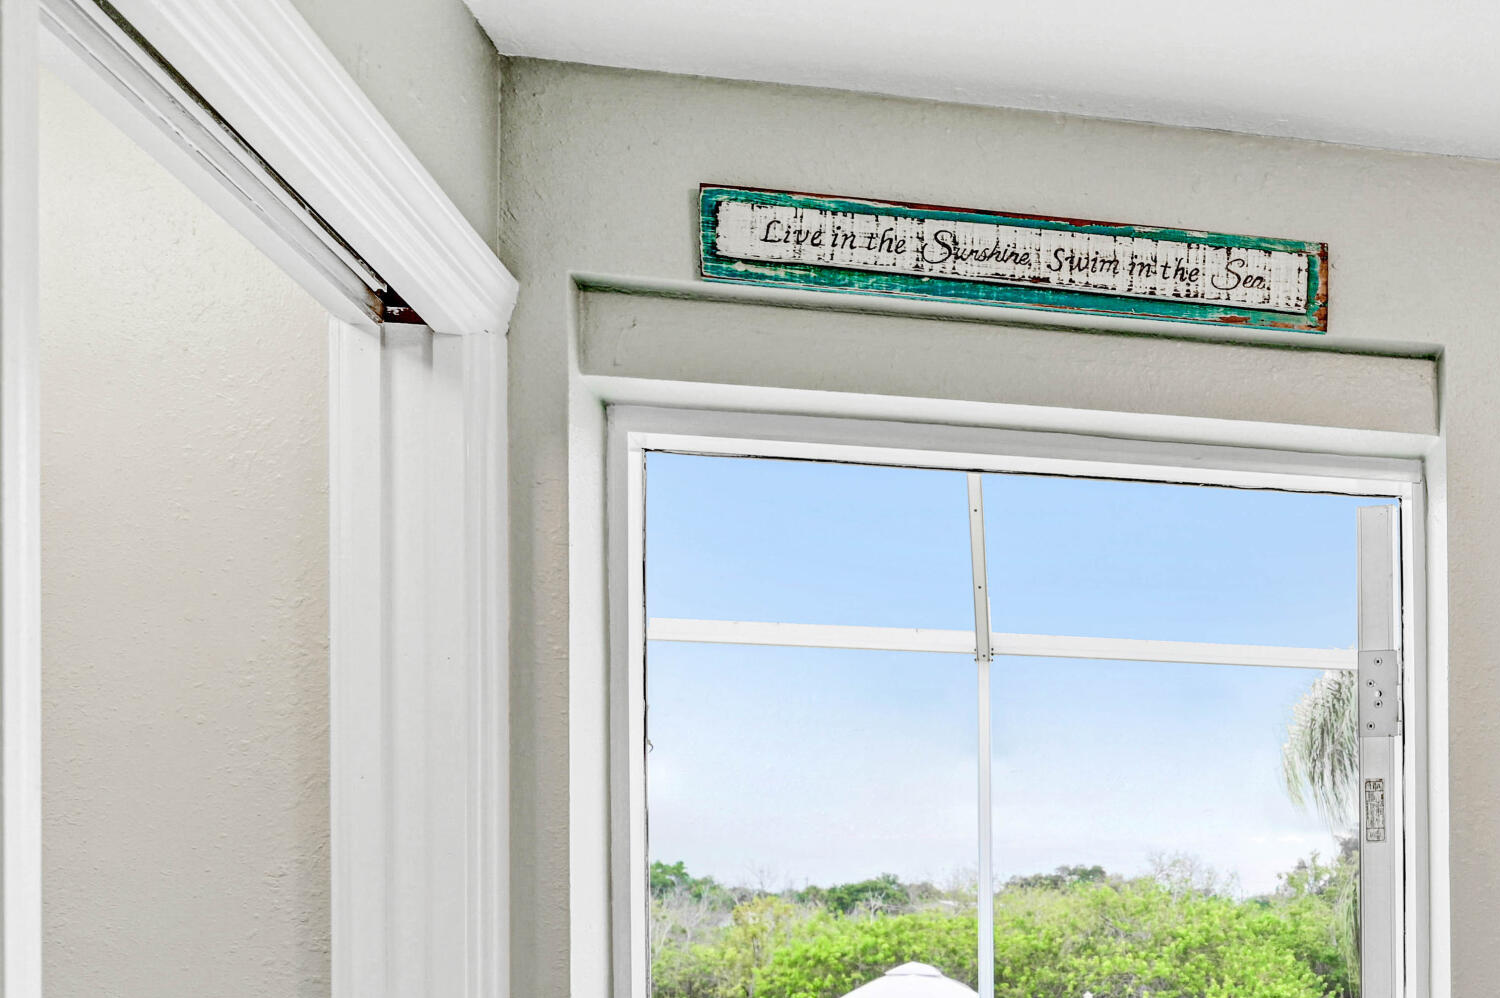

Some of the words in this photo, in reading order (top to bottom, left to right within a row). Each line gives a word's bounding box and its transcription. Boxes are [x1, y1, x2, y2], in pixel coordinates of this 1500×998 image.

[760, 219, 823, 247] Live
[831, 225, 856, 250] in
[867, 227, 906, 254] the
[1047, 247, 1120, 275] Swim
[1128, 253, 1152, 278] in
[1160, 257, 1200, 283] the
